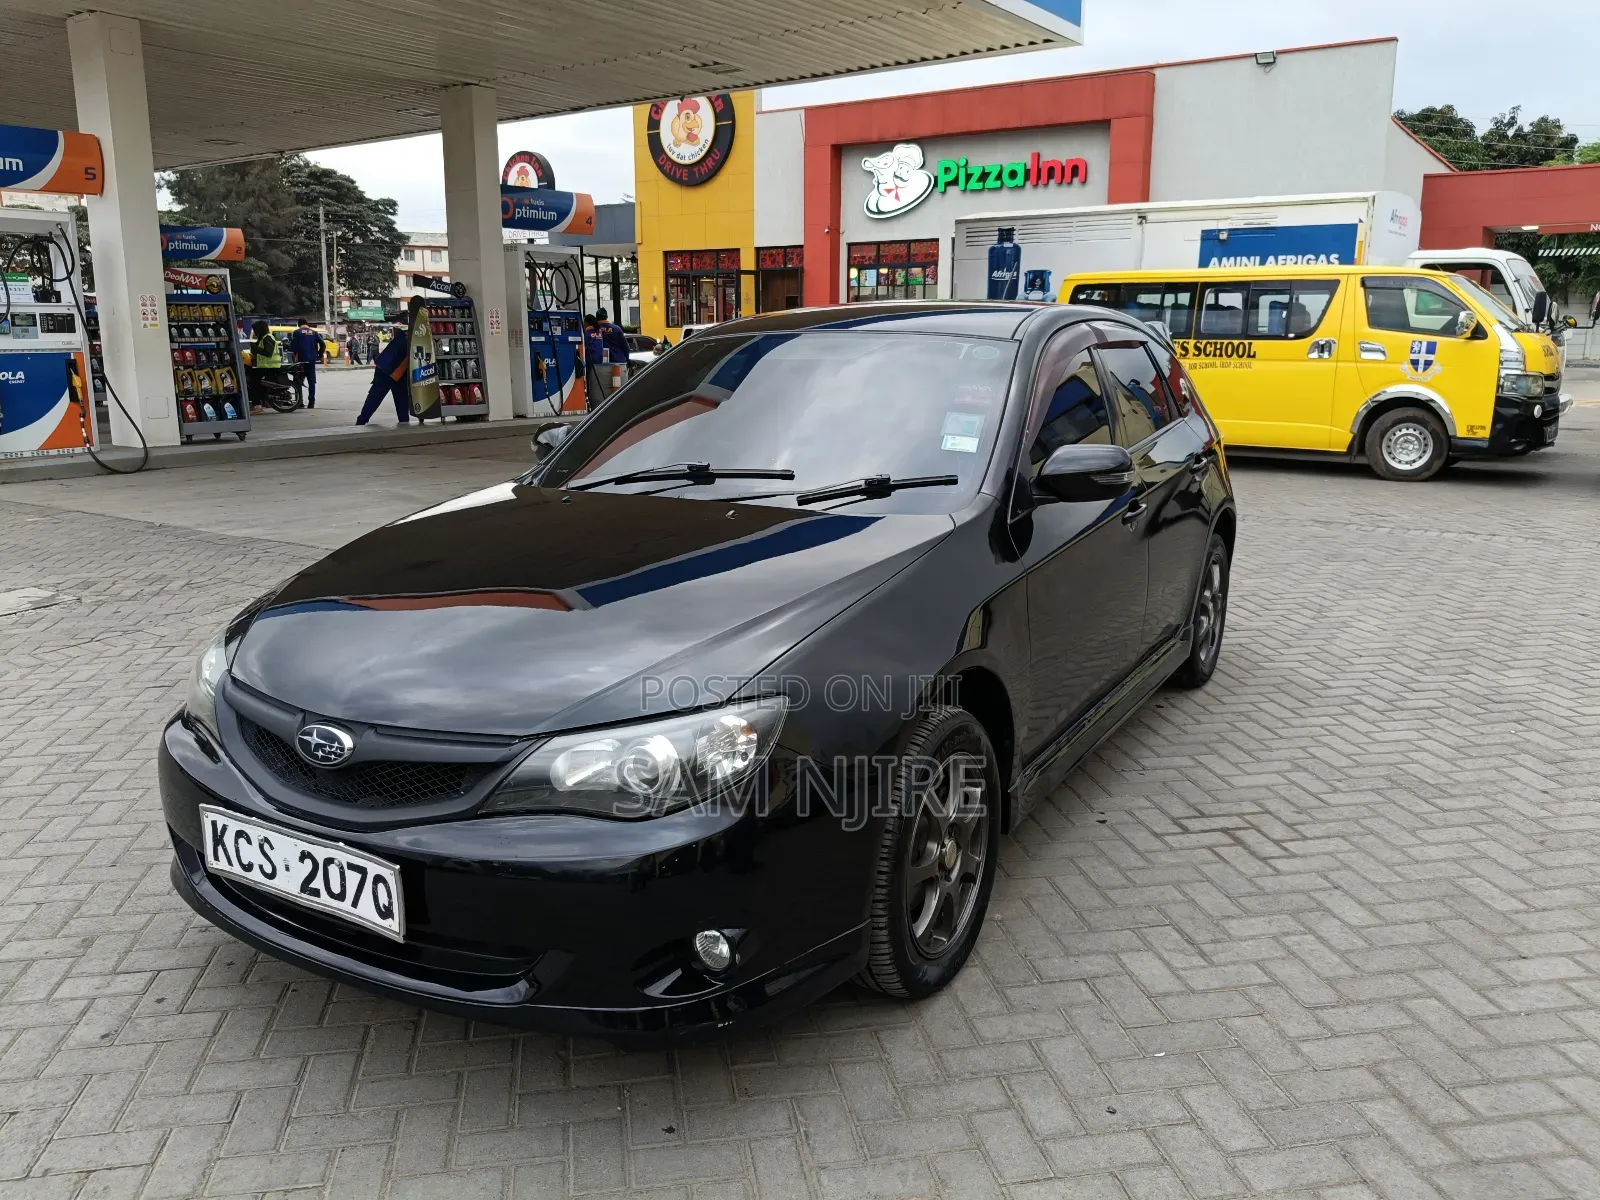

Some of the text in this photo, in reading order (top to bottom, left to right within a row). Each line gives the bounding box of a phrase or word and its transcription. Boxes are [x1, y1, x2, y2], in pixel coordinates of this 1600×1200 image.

[666, 138, 709, 161] luv dat chicken
[503, 153, 543, 181] Chicken Inn
[658, 148, 720, 181] DRIVE THRU
[84, 166, 97, 181] 5
[585, 216, 593, 226] 4
[235, 246, 243, 254] 2
[1207, 255, 1261, 269] AMINI
[164, 270, 203, 287] DeoMAX
[429, 280, 453, 293] Accel
[1192, 340, 1257, 359] SCHOOL
[0, 371, 25, 381] OLA
[419, 365, 435, 378] Accel
[211, 819, 395, 922] KCS 207Q
